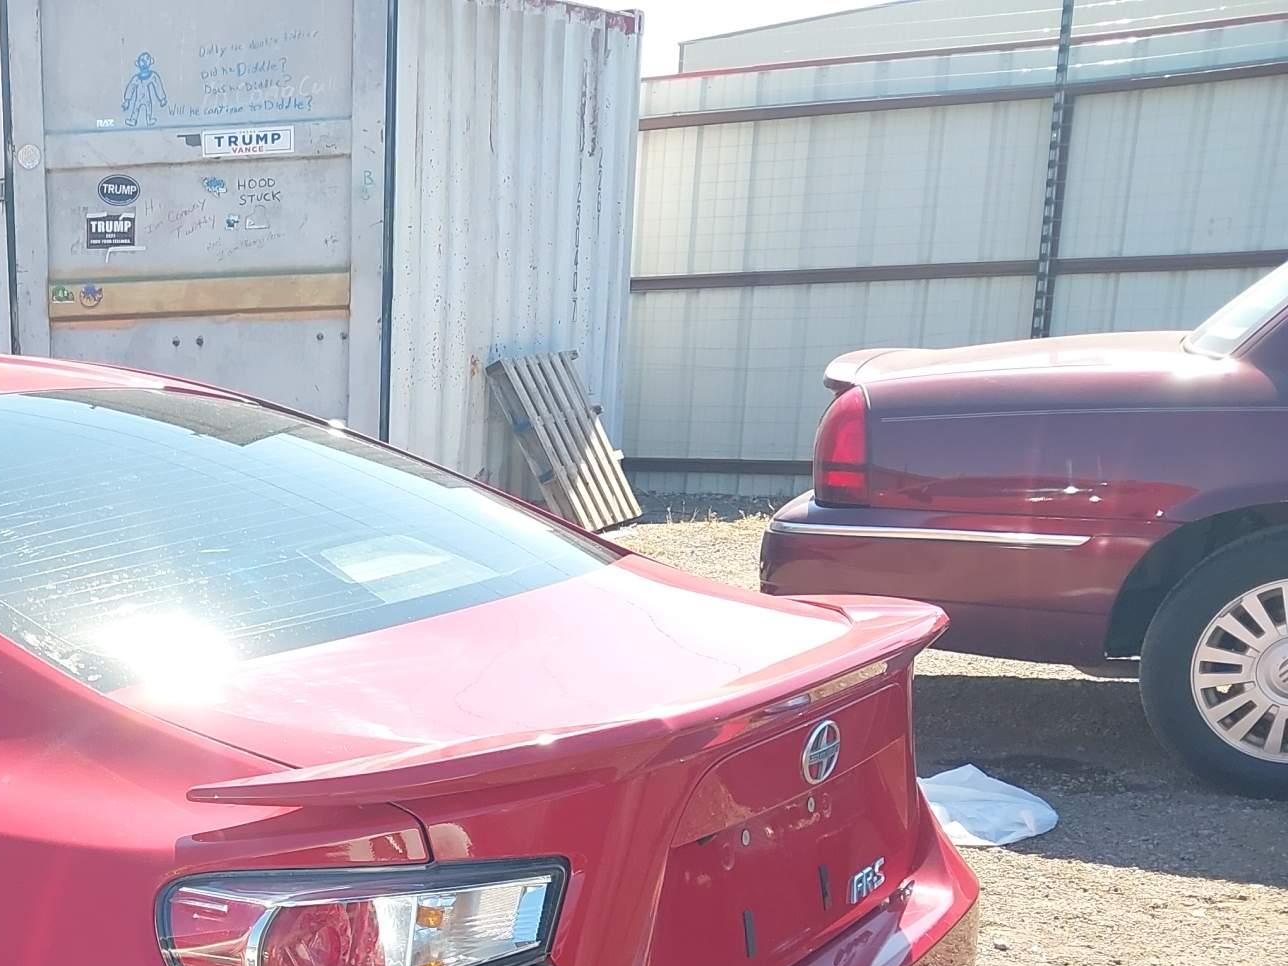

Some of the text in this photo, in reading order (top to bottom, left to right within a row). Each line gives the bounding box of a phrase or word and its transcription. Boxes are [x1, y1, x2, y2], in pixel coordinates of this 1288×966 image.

[236, 57, 287, 76] Diddle?
[168, 103, 185, 116] Will
[189, 105, 200, 117] he
[264, 95, 313, 112] Diddle?
[214, 132, 281, 148] TRUMP
[231, 145, 264, 154] VANCE
[102, 183, 137, 195] TRUMP
[237, 178, 275, 191] HOOD
[239, 191, 281, 206] STUCK
[90, 220, 132, 233] TRUMP
